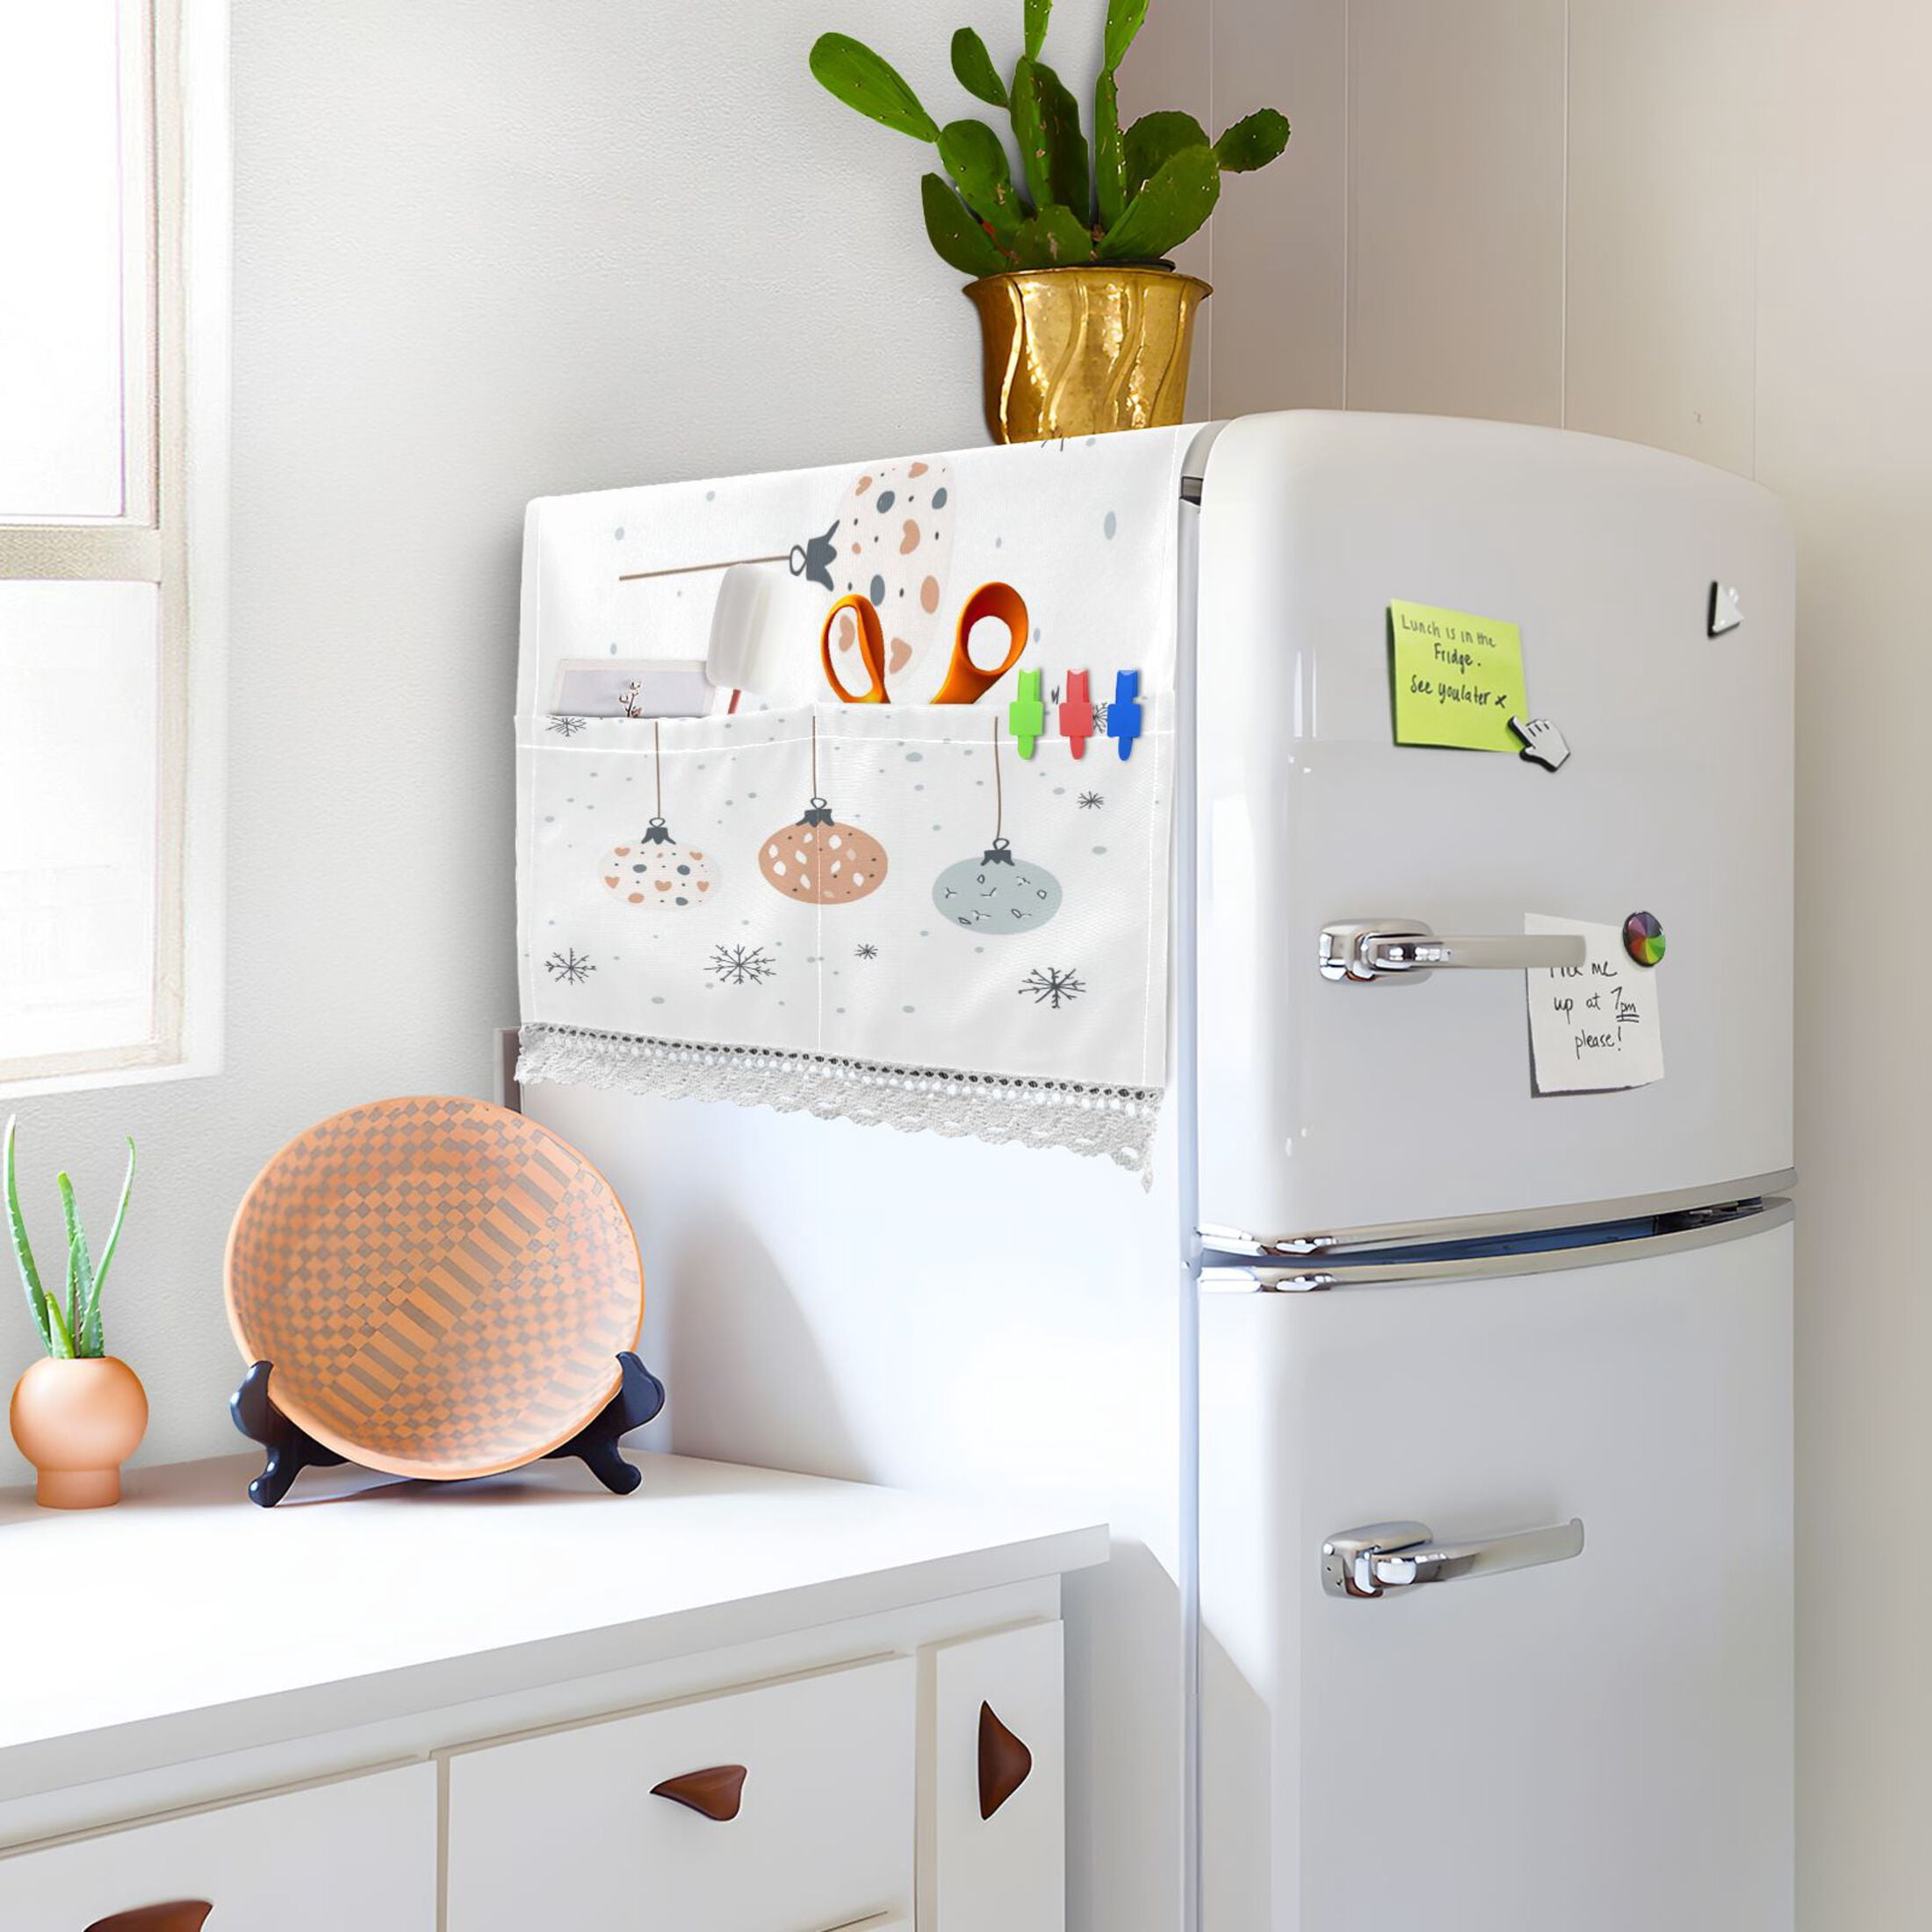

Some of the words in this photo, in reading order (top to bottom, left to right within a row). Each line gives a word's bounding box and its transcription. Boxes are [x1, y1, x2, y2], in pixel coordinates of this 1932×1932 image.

[1402, 614, 1441, 638] Lunch
[1477, 631, 1497, 648] the
[1410, 674, 1433, 693] See
[1591, 961, 1618, 977] me
[1554, 997, 1574, 1024] up
[1586, 992, 1601, 1010] at
[1575, 1026, 1622, 1060] please!
